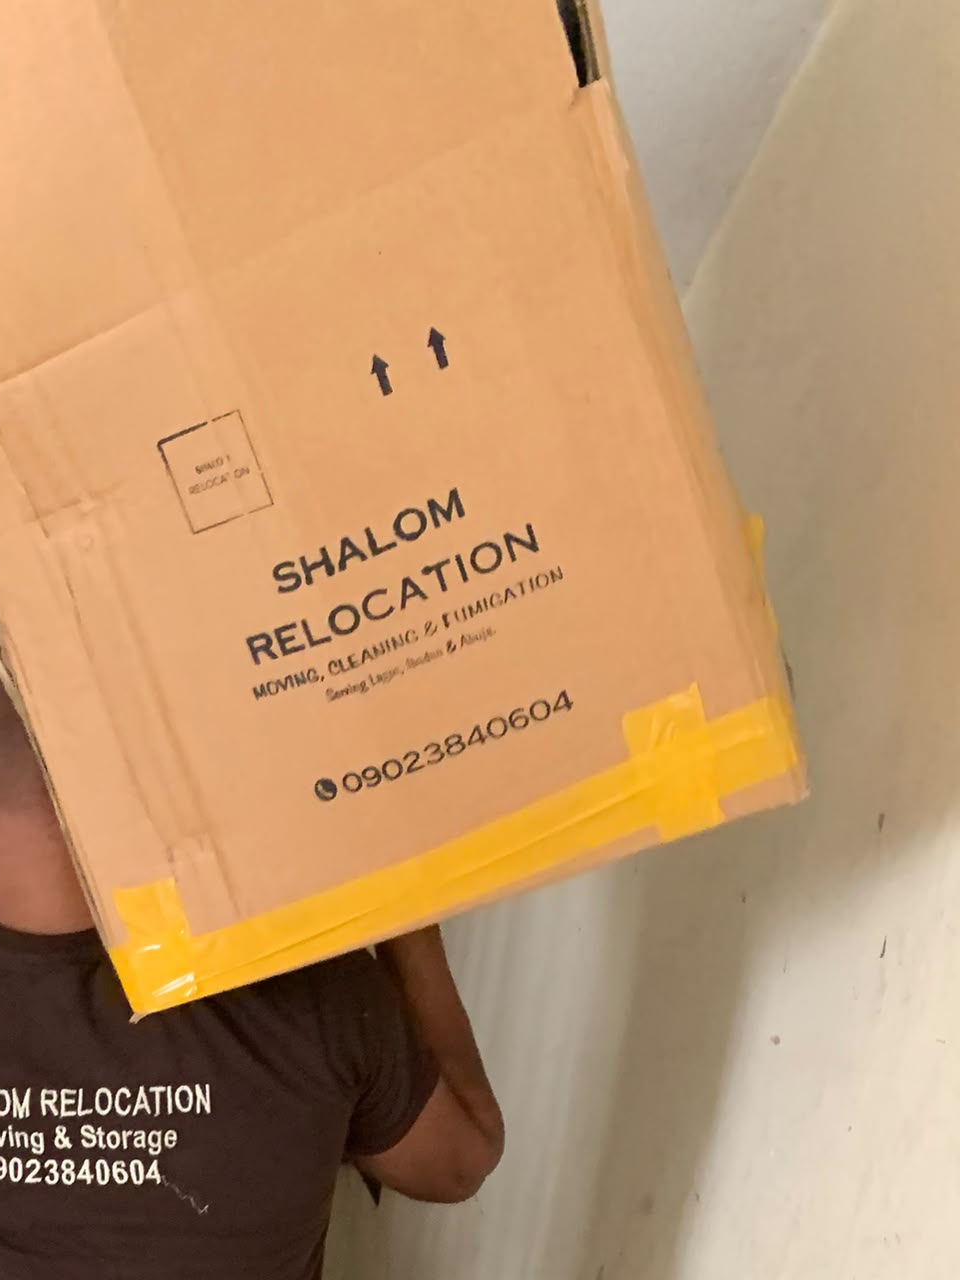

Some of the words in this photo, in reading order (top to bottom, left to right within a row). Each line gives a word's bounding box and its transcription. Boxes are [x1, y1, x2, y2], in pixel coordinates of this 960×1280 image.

[188, 466, 250, 494] RELOCAON
[272, 488, 466, 594] SHALOM
[246, 524, 540, 666] RELOCATION
[252, 668, 325, 700] MOVING,
[327, 629, 419, 676] CLEANING
[424, 620, 438, 637] &
[441, 565, 564, 629] FUMIGATION
[446, 639, 457, 654] &
[342, 689, 575, 794] 09023840604
[40, 1084, 212, 1117] RELOCATION
[53, 1125, 73, 1149] &
[80, 1125, 178, 1155] Storage
